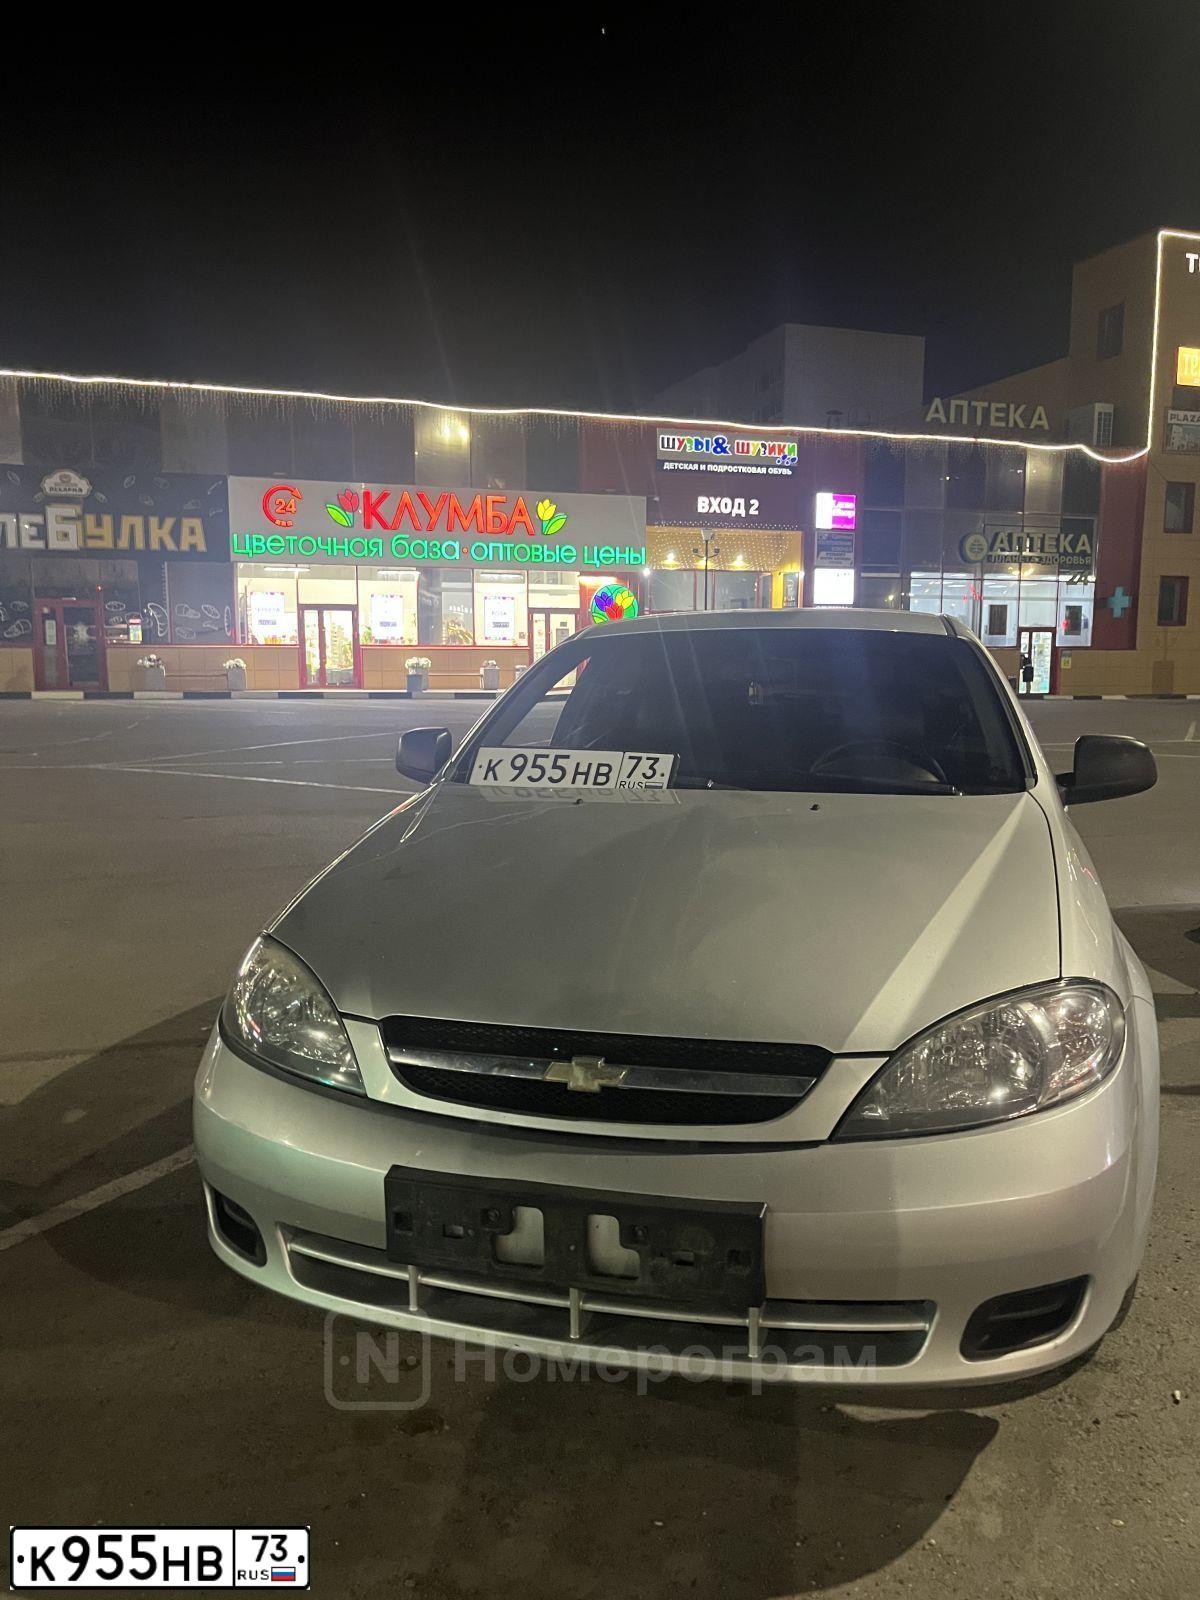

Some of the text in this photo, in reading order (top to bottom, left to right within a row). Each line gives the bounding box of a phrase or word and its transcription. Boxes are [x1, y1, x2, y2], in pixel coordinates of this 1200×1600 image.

[925, 398, 1049, 430] АПТЕКА
[735, 440, 797, 458] ШУЗИКИ
[664, 462, 698, 471] ДЕТСКАЯ
[707, 464, 767, 475] ПОДРОСТКОВАЯ
[275, 498, 297, 514] 24
[362, 489, 535, 535] КЛУМБА
[697, 496, 760, 518] ВХОД 2
[391, 534, 460, 561] база
[470, 542, 577, 565] оптовые
[583, 545, 646, 568] цены
[992, 531, 1092, 554] АПТЕКА
[626, 756, 660, 780] 73
[619, 781, 643, 789] RUS
